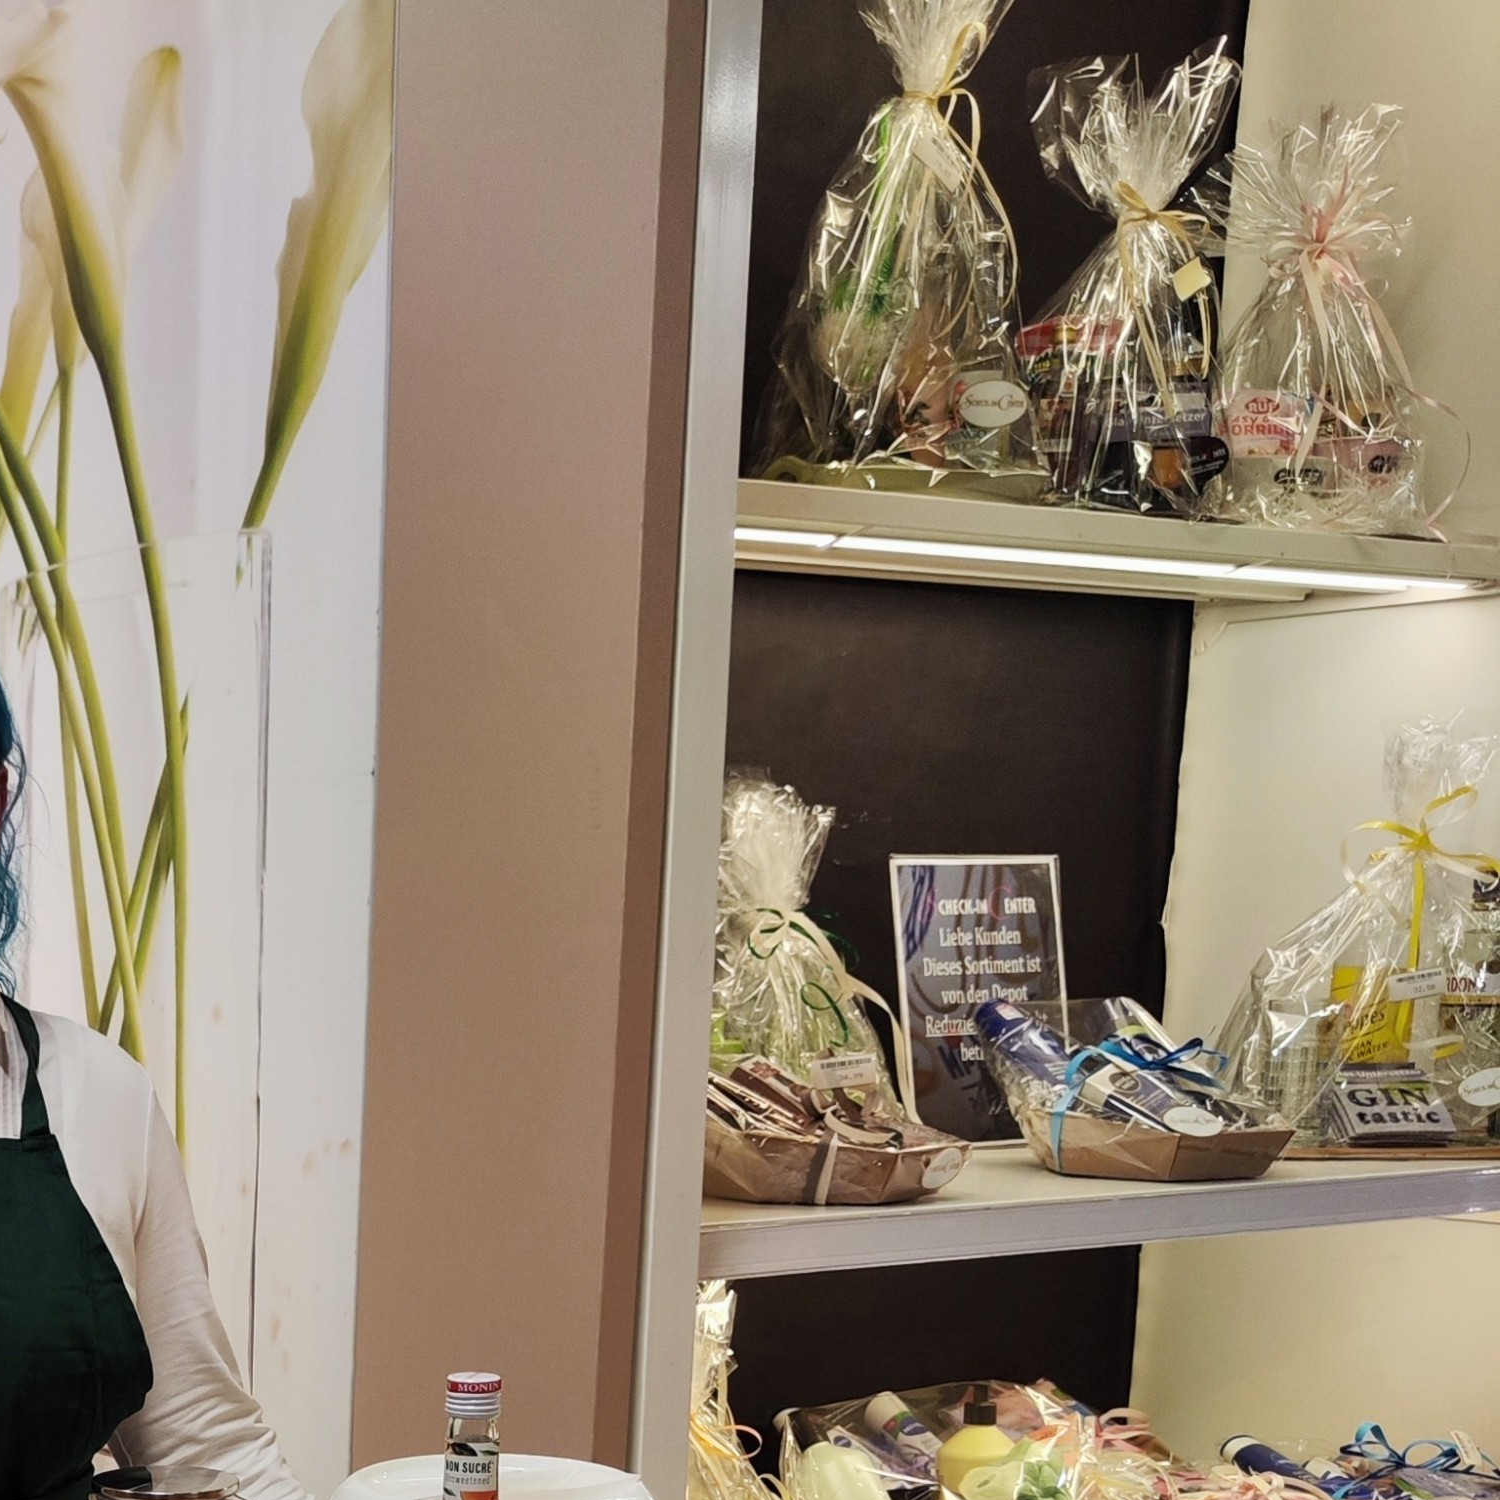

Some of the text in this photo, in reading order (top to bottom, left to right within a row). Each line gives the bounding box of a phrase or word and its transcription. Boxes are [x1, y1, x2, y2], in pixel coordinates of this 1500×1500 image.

[938, 925, 1022, 947] Liebe Kunden
[923, 955, 1042, 977] Dieses Sortiment ist
[941, 984, 1029, 1005] von den Depot
[1346, 1087, 1431, 1107] GIN
[1355, 1108, 1441, 1125] tastic
[457, 1382, 500, 1392] MONIN
[445, 1459, 460, 1473] NON
